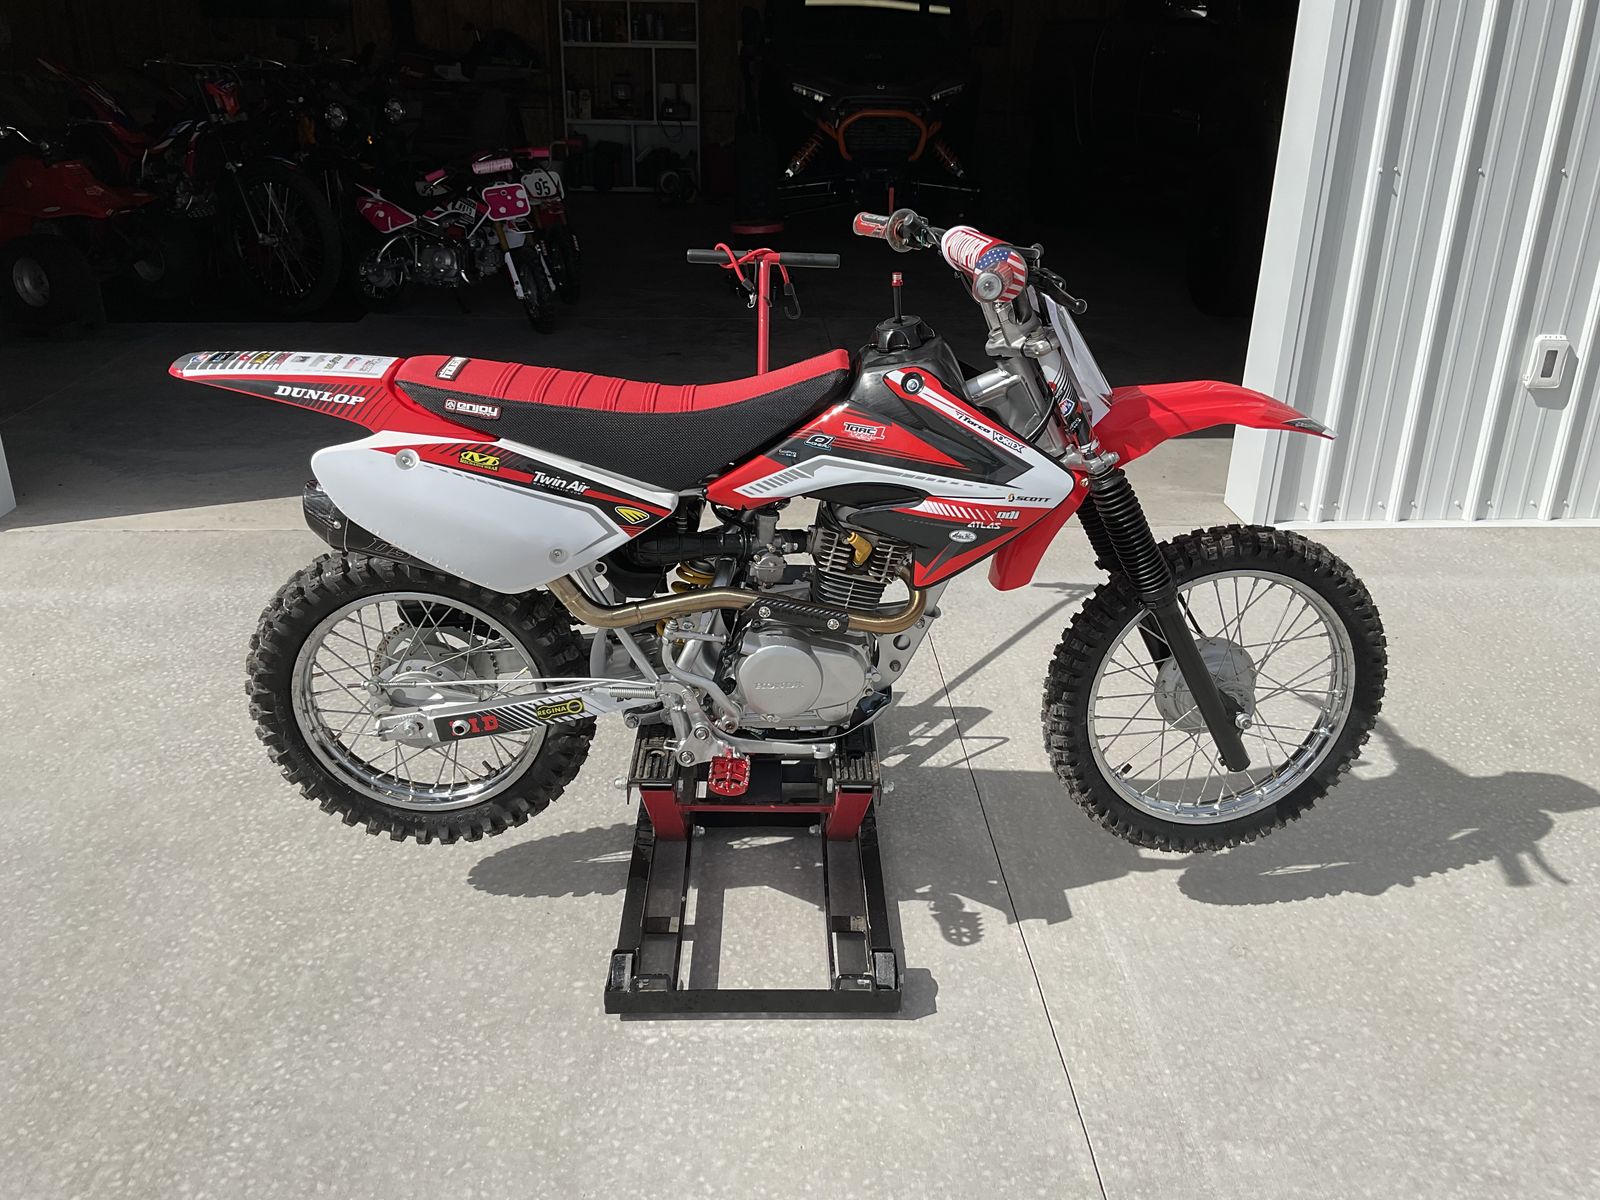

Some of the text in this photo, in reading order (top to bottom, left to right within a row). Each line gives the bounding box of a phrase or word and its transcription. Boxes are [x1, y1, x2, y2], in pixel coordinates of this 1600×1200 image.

[534, 181, 551, 196] 95
[274, 384, 366, 406] DUNLOP
[456, 401, 500, 417] enjoy
[992, 430, 1026, 454] VORTEX
[532, 470, 591, 494] Twin Air
[1015, 495, 1052, 503] SCOTT
[967, 520, 1002, 530] ATLAS
[536, 705, 568, 717] REGINA
[450, 715, 499, 737] ID
